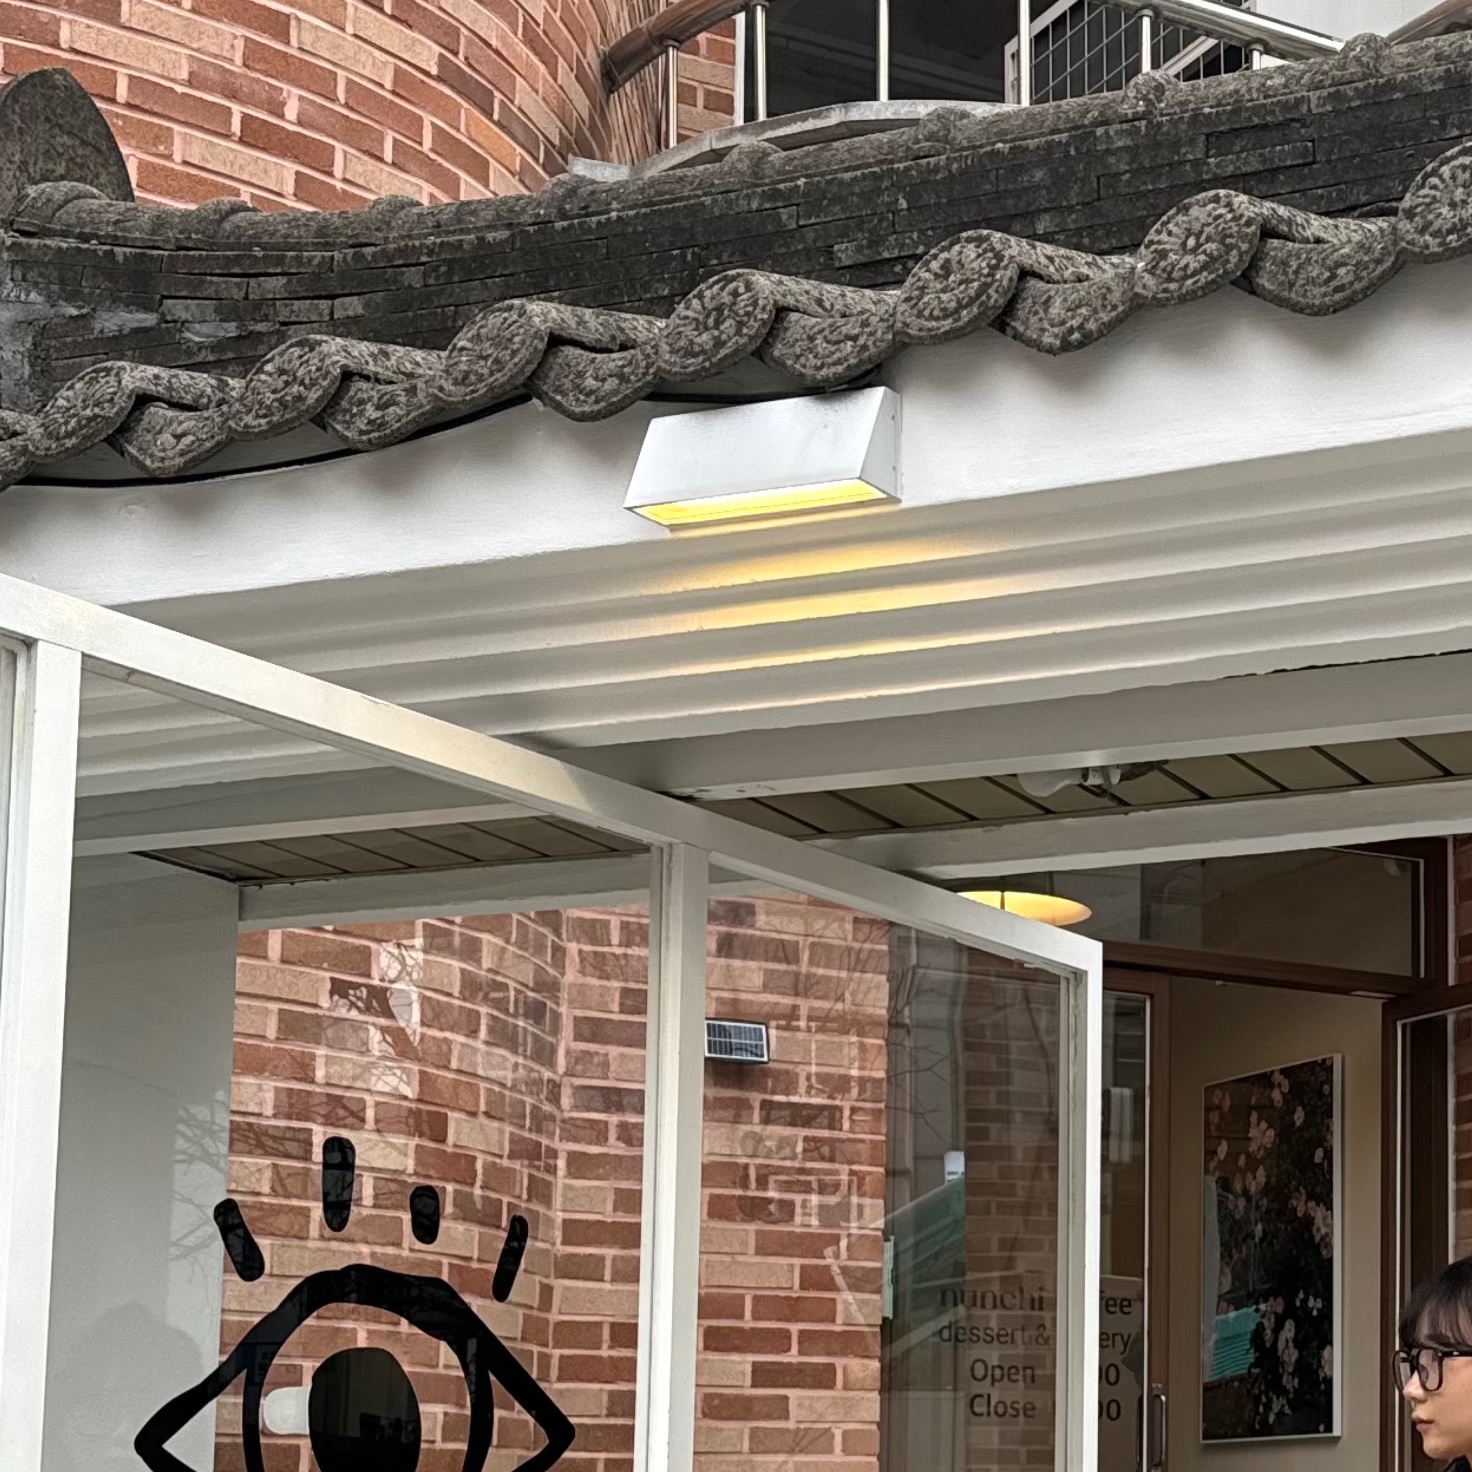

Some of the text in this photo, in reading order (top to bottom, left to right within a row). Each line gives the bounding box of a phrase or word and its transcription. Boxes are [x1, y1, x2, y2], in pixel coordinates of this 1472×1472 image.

[940, 1286, 1045, 1312] nunchi
[938, 1319, 1027, 1345] dessert
[1034, 1323, 1051, 1346] &
[969, 1358, 1036, 1387] Open
[969, 1393, 1037, 1419] Close
